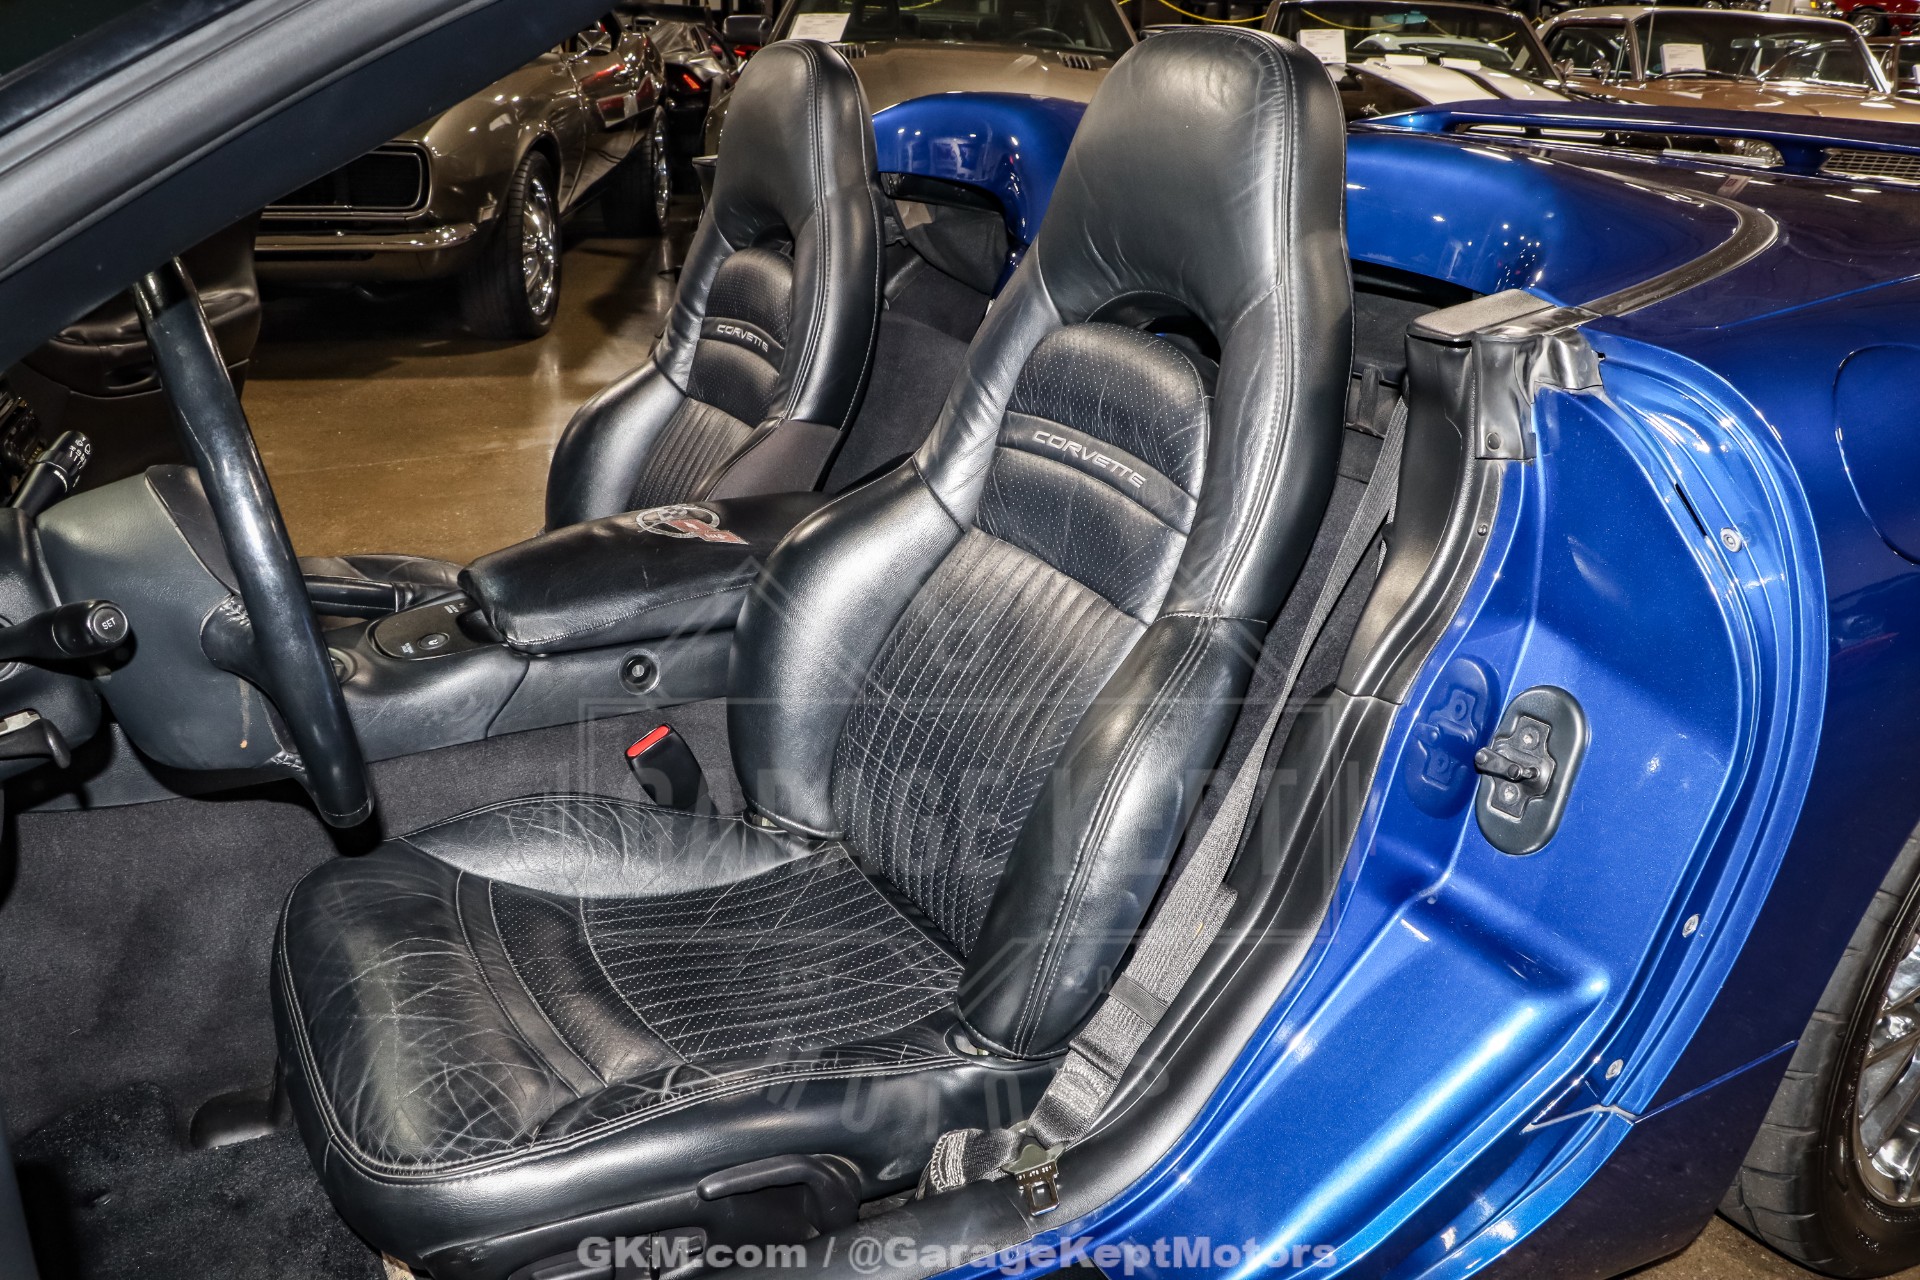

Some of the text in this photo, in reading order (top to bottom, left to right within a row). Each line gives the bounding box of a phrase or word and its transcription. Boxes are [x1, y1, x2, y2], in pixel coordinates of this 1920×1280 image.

[716, 324, 769, 353] CORVETTE
[1031, 430, 1148, 489] CORVETTE
[101, 617, 116, 630] SET
